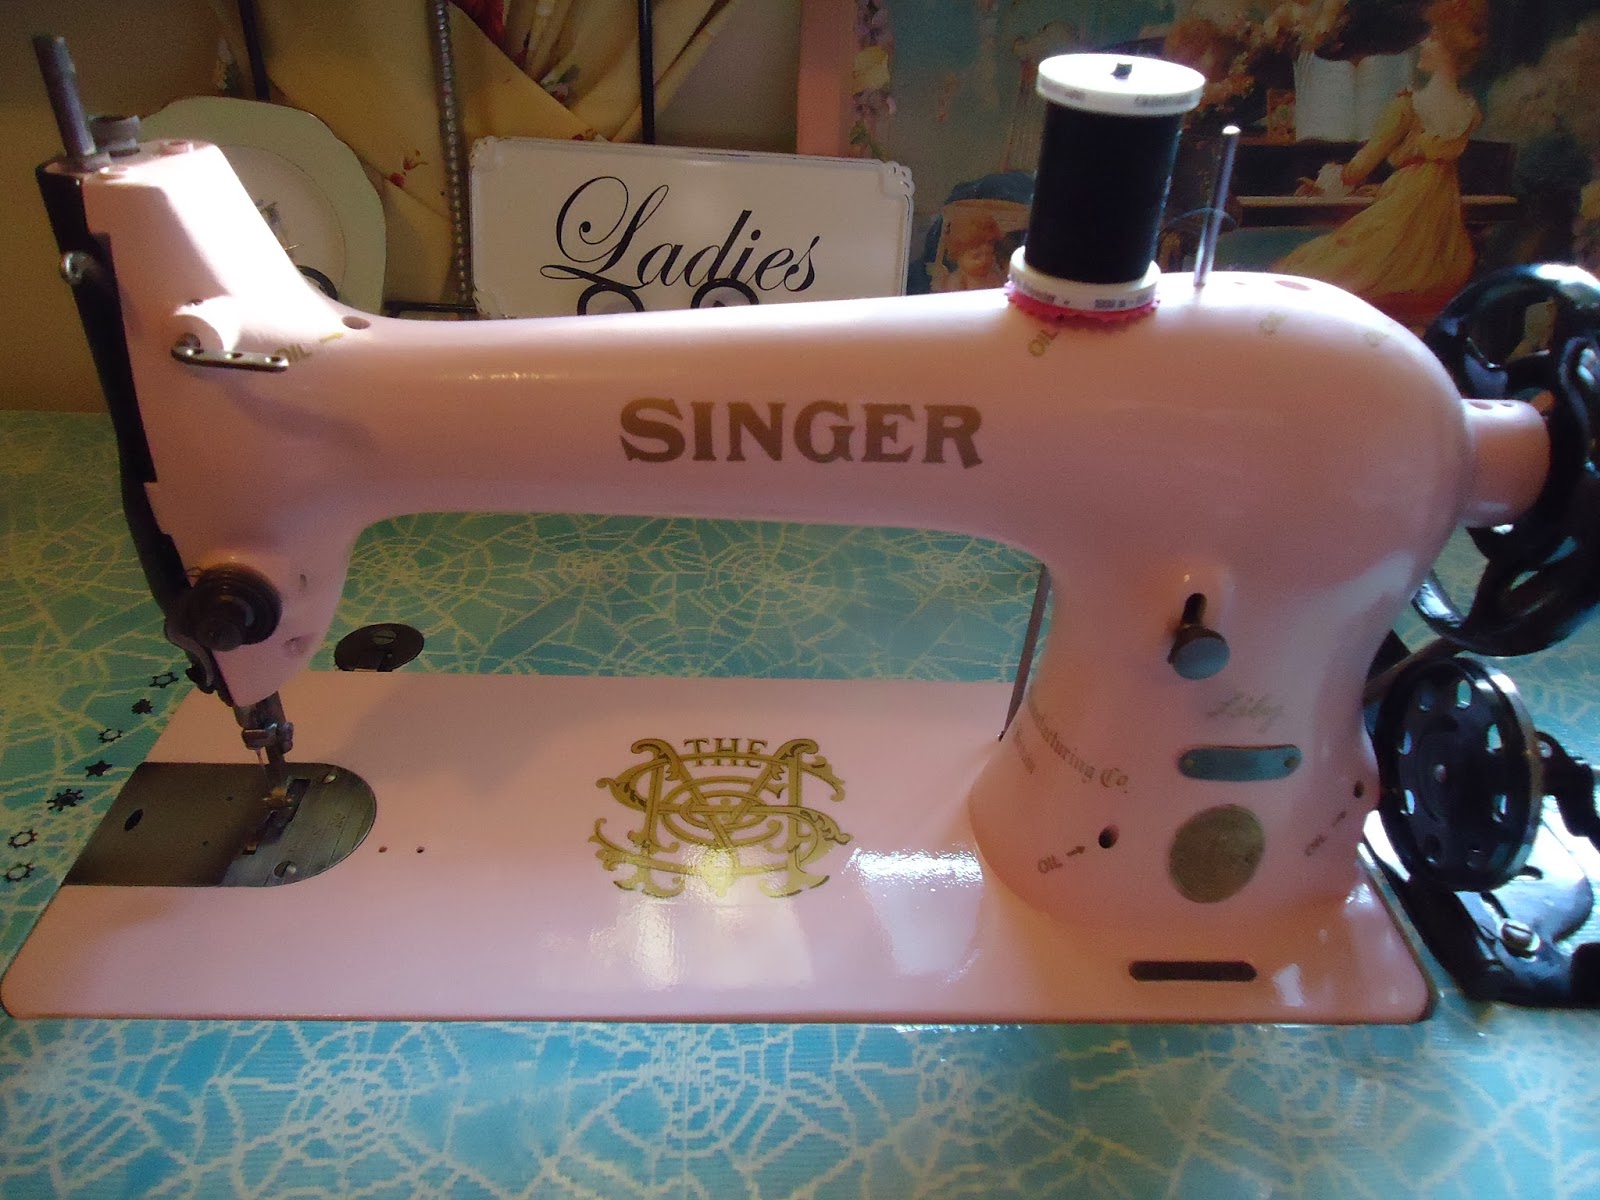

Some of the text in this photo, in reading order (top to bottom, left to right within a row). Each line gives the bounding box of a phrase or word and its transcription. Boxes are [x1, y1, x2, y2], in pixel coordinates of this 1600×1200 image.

[540, 176, 821, 292] Ladies
[619, 397, 983, 470] SINGER
[684, 737, 768, 768] THE
[1038, 855, 1063, 874] OIL
